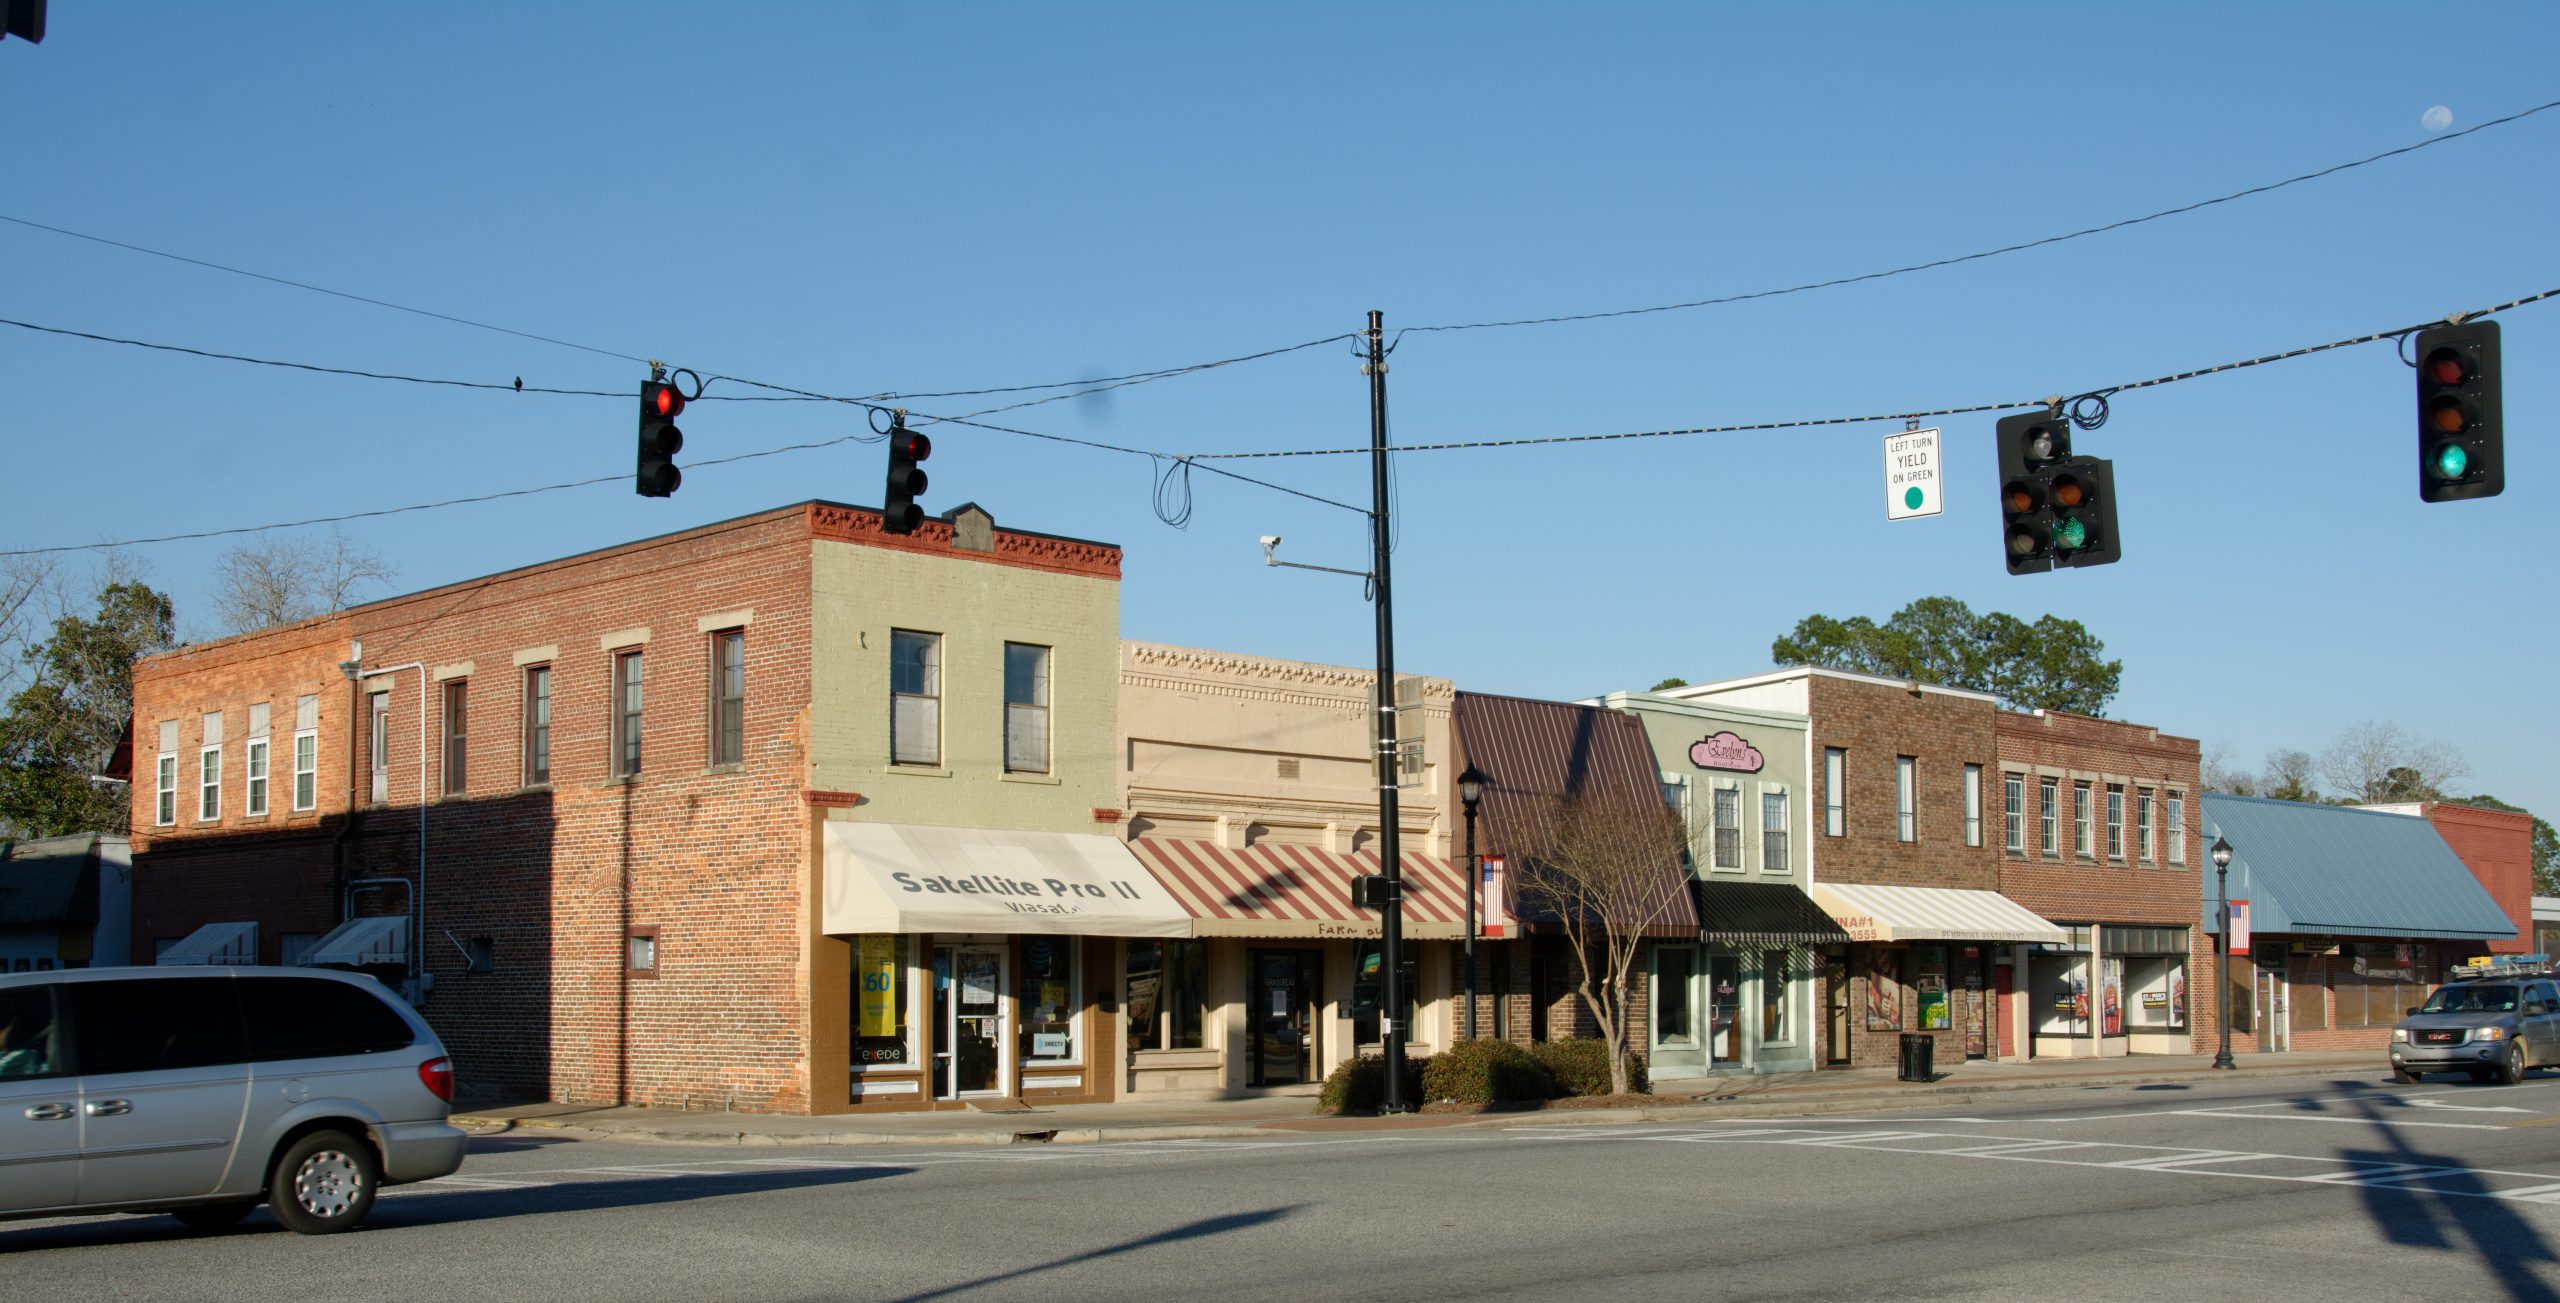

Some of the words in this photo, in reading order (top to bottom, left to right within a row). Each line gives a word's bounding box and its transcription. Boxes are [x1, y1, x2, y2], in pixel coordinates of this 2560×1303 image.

[1891, 440, 1908, 452] LEFT
[1912, 437, 1932, 449] TURN
[1898, 453, 1927, 468] YIELD
[1893, 474, 1904, 484] ON
[1907, 469, 1933, 482] GREEN
[1708, 740, 1747, 760] Evelyn's
[892, 872, 1042, 896] Satellite
[1042, 878, 1106, 898] Pro
[1110, 881, 1141, 900] II
[1835, 916, 1873, 928] INA#1
[1851, 929, 1877, 941] 3555
